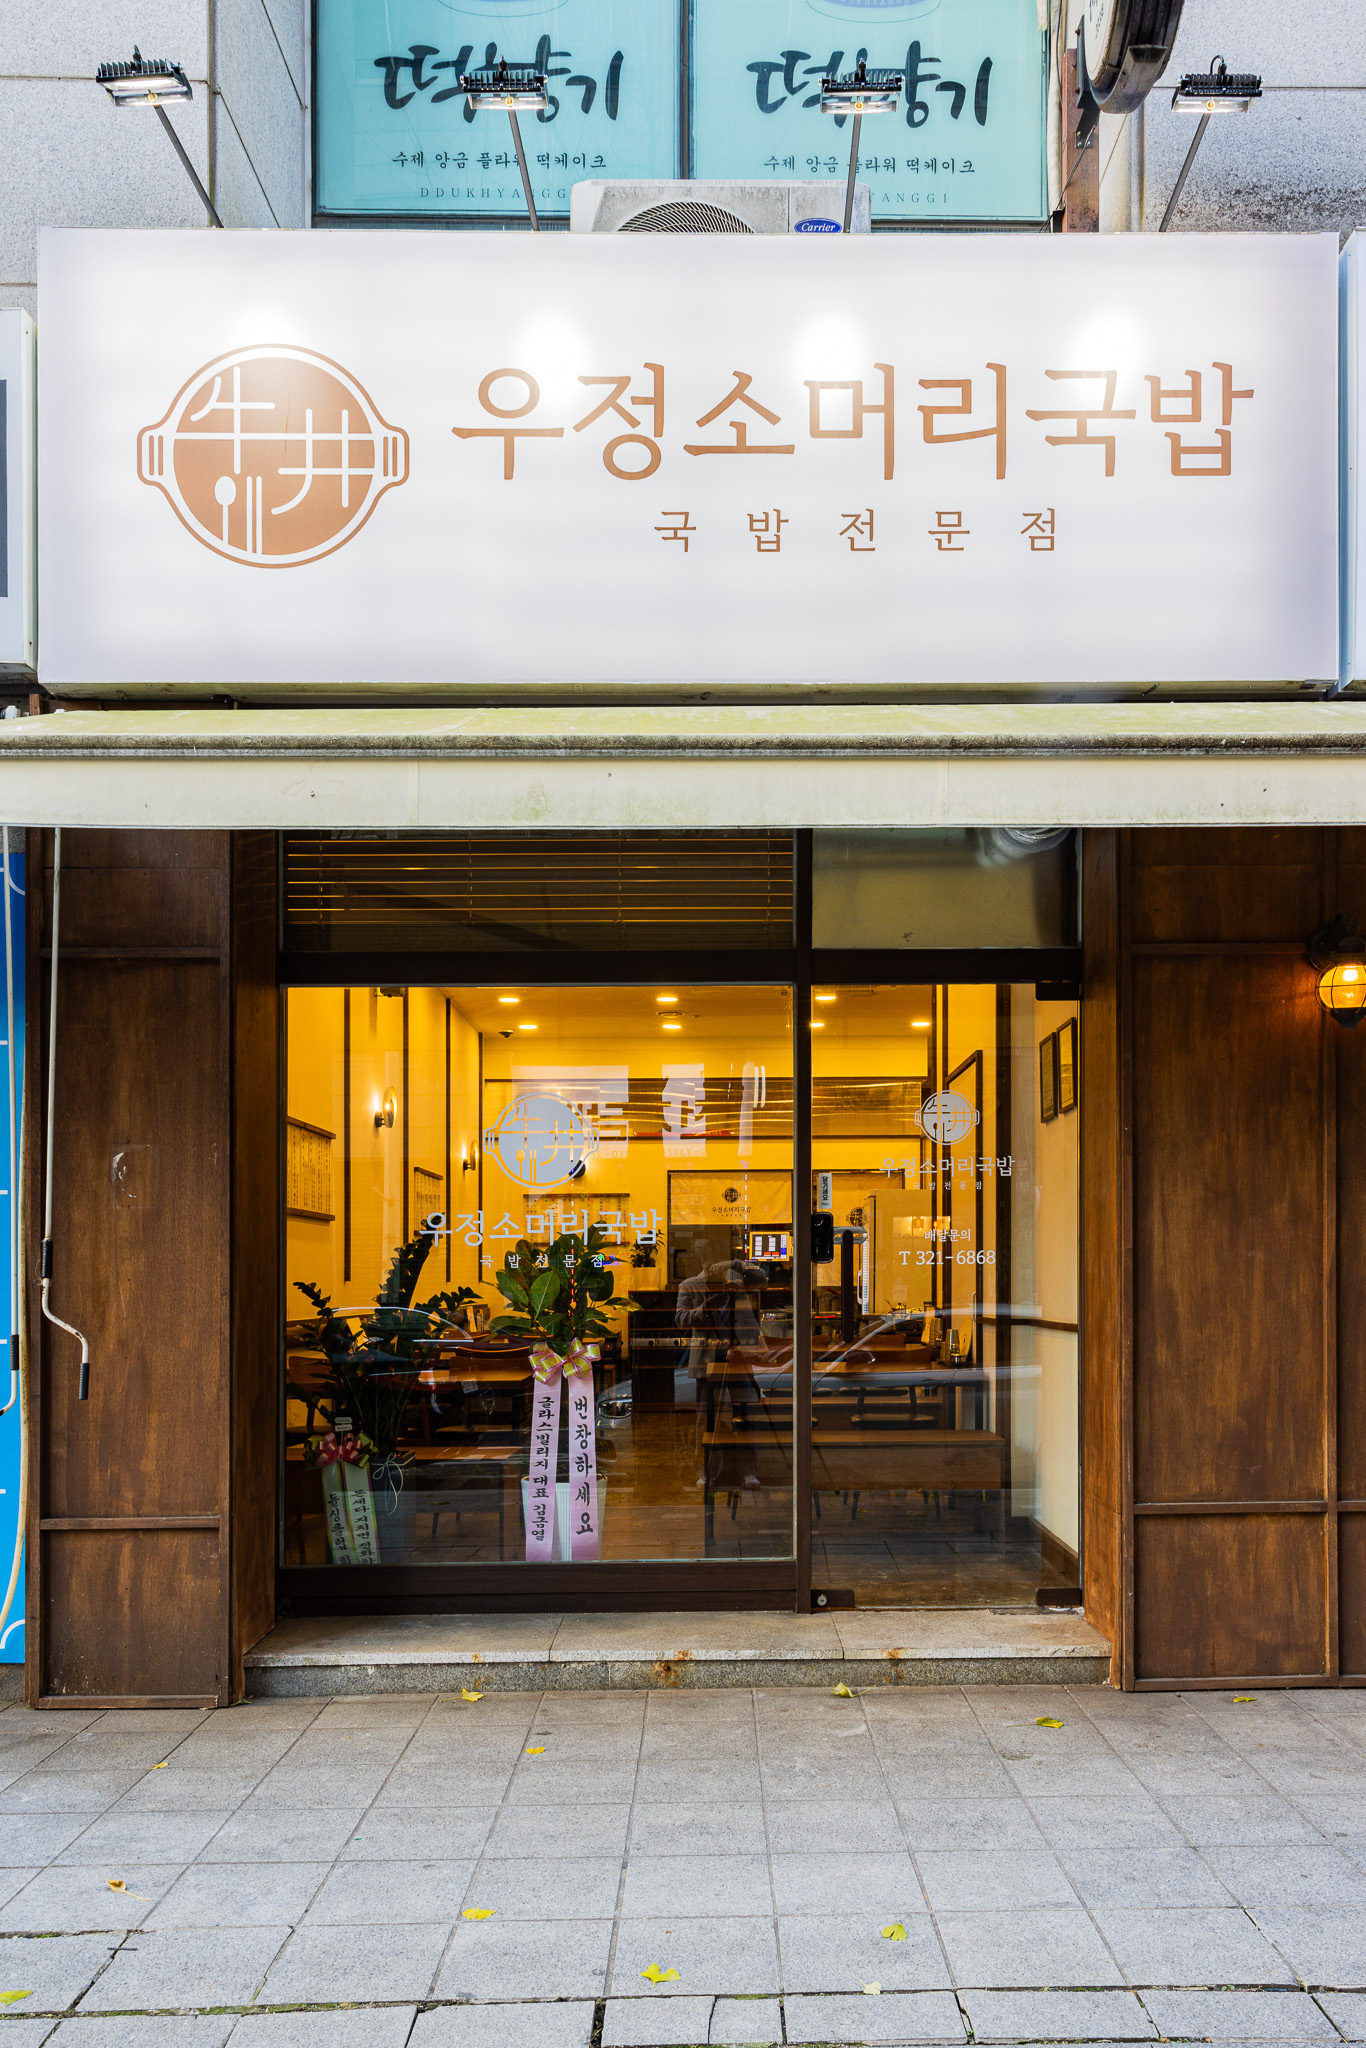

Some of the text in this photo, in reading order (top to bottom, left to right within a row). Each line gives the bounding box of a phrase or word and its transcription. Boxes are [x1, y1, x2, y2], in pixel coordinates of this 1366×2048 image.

[392, 151, 424, 169] 수제
[435, 151, 469, 170] 앙금
[536, 152, 607, 170] 떡케이크
[763, 155, 796, 172] 수제
[806, 155, 839, 174] 앙금
[906, 158, 976, 175] 떡케이크
[420, 187, 567, 199] DDUKHYAGG
[801, 223, 836, 232] Carrier
[451, 362, 1254, 481] 우정소머리국밥
[879, 1155, 1016, 1178] 우정소머리국밥
[418, 1208, 664, 1247] 우정소머리국밥
[924, 1228, 971, 1242] 배달문의
[899, 1250, 996, 1265] T 321-6868
[534, 1396, 554, 1470] 글라스빌리지
[574, 1395, 593, 1535] 번창하세요
[532, 1474, 549, 1499] 대표
